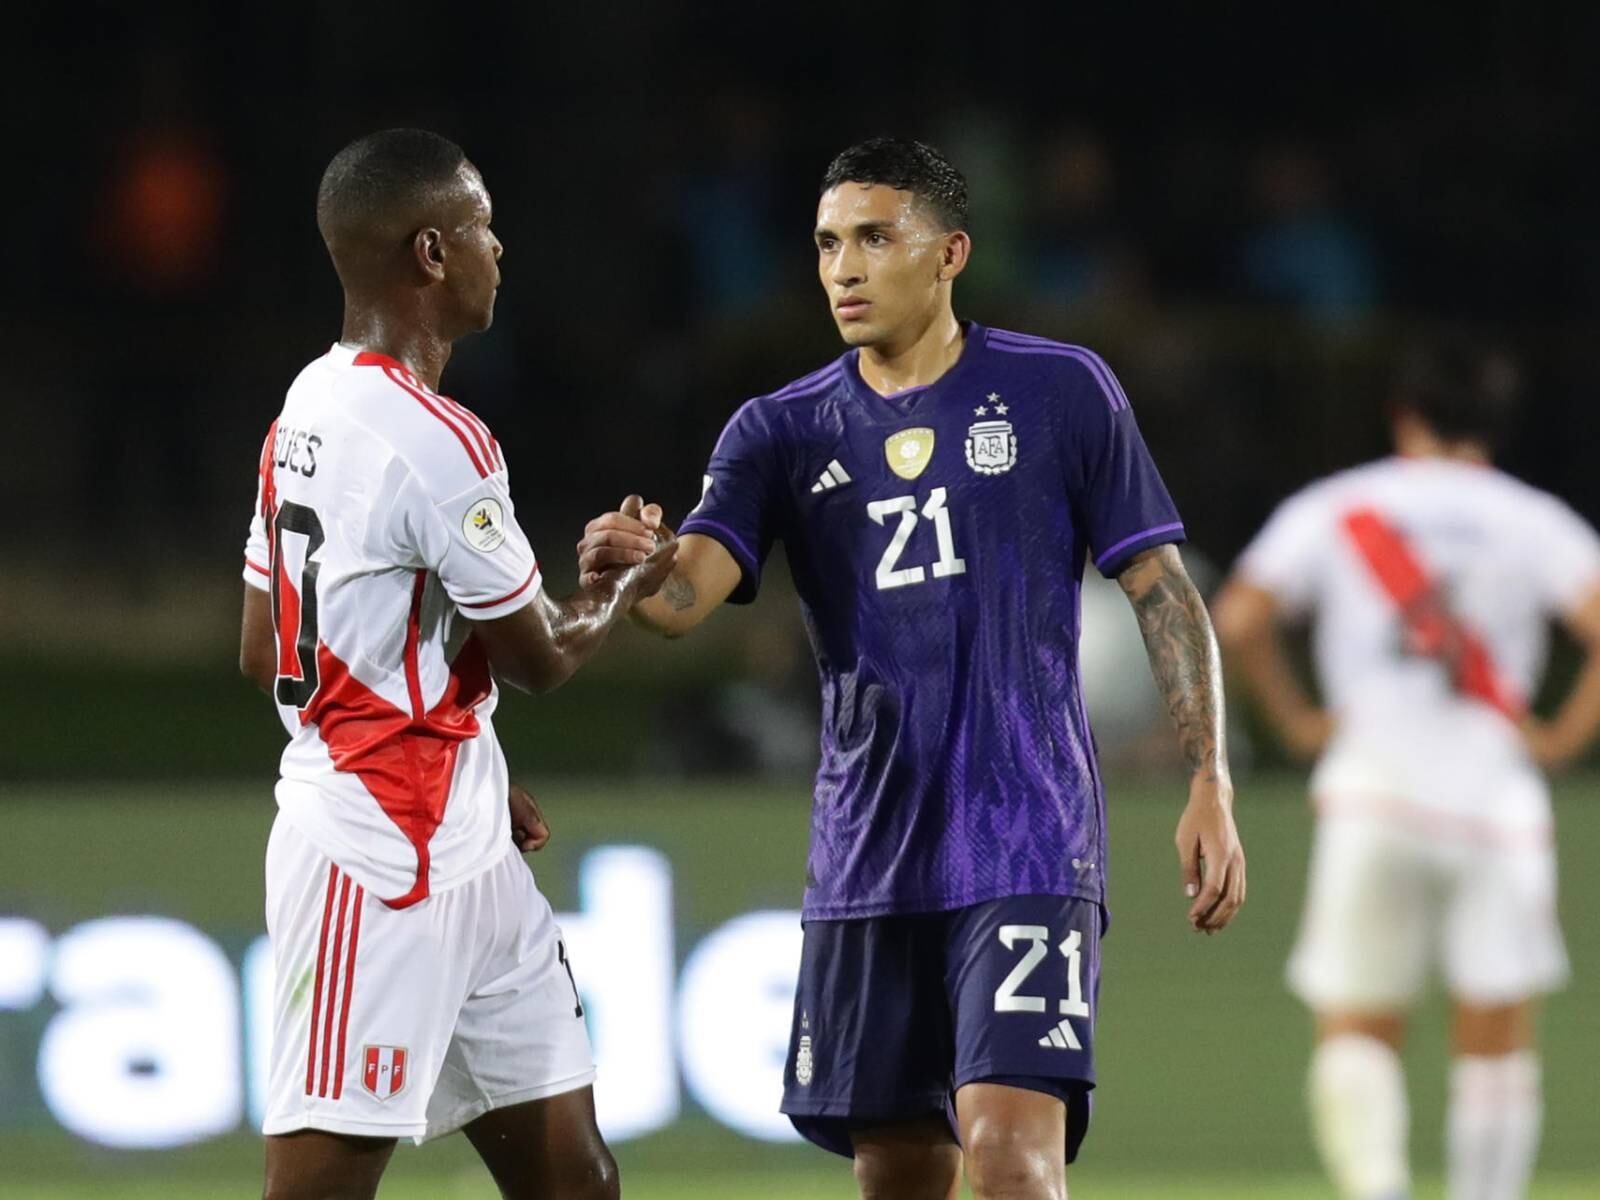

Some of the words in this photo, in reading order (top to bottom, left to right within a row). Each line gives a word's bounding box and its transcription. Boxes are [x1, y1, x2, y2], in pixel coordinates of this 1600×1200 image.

[274, 427, 322, 478] UES
[978, 435, 1005, 458] AFA
[867, 487, 966, 590] 21
[994, 924, 1089, 1018] 21
